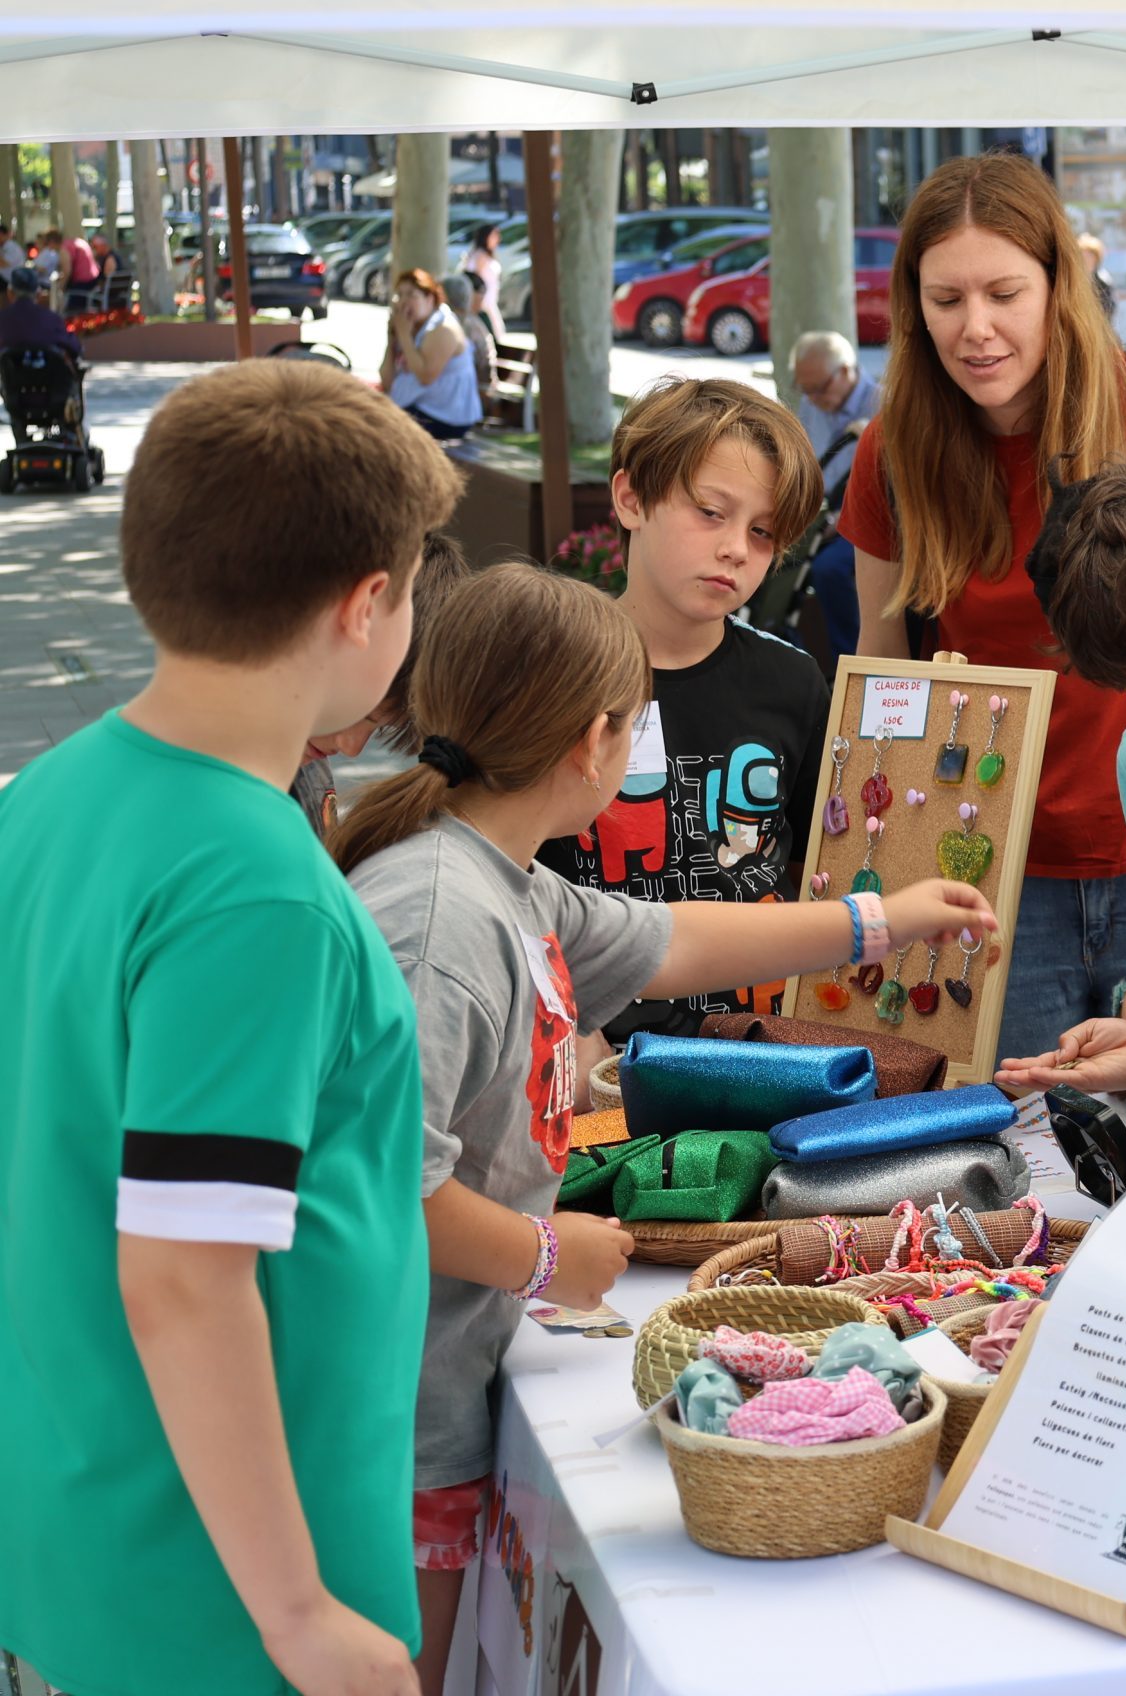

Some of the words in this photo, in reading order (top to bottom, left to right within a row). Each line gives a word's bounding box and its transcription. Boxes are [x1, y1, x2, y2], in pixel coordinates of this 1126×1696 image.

[874, 681, 909, 690] CLAUERS
[911, 681, 921, 690] DE
[881, 698, 909, 707] RESINA
[1113, 1313, 1124, 1323] de
[1113, 1334, 1123, 1344] de
[1117, 1356, 1126, 1366] de
[1082, 1432, 1093, 1442] de
[1055, 1445, 1070, 1456] per
